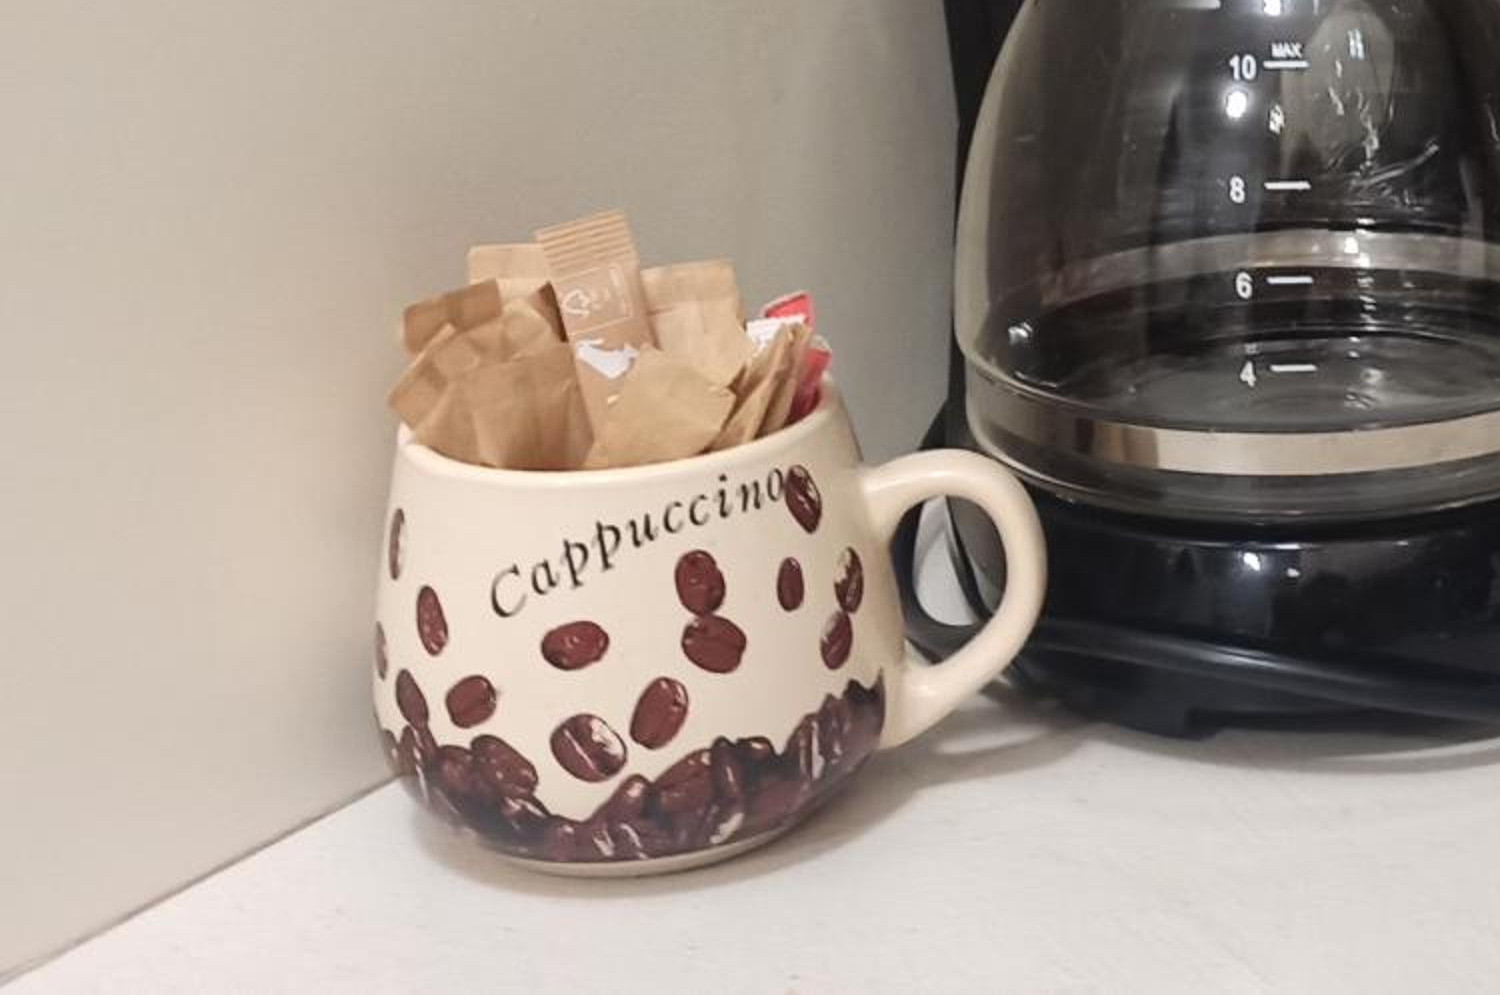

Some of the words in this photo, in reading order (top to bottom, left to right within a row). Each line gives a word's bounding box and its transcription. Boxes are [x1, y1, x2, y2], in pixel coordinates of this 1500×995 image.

[1271, 42, 1302, 57] MAX
[1229, 55, 1257, 80] 10
[1229, 176, 1246, 203] 8
[1235, 271, 1253, 300] 6
[1239, 360, 1257, 387] 4
[489, 468, 785, 618] Cappuccino
